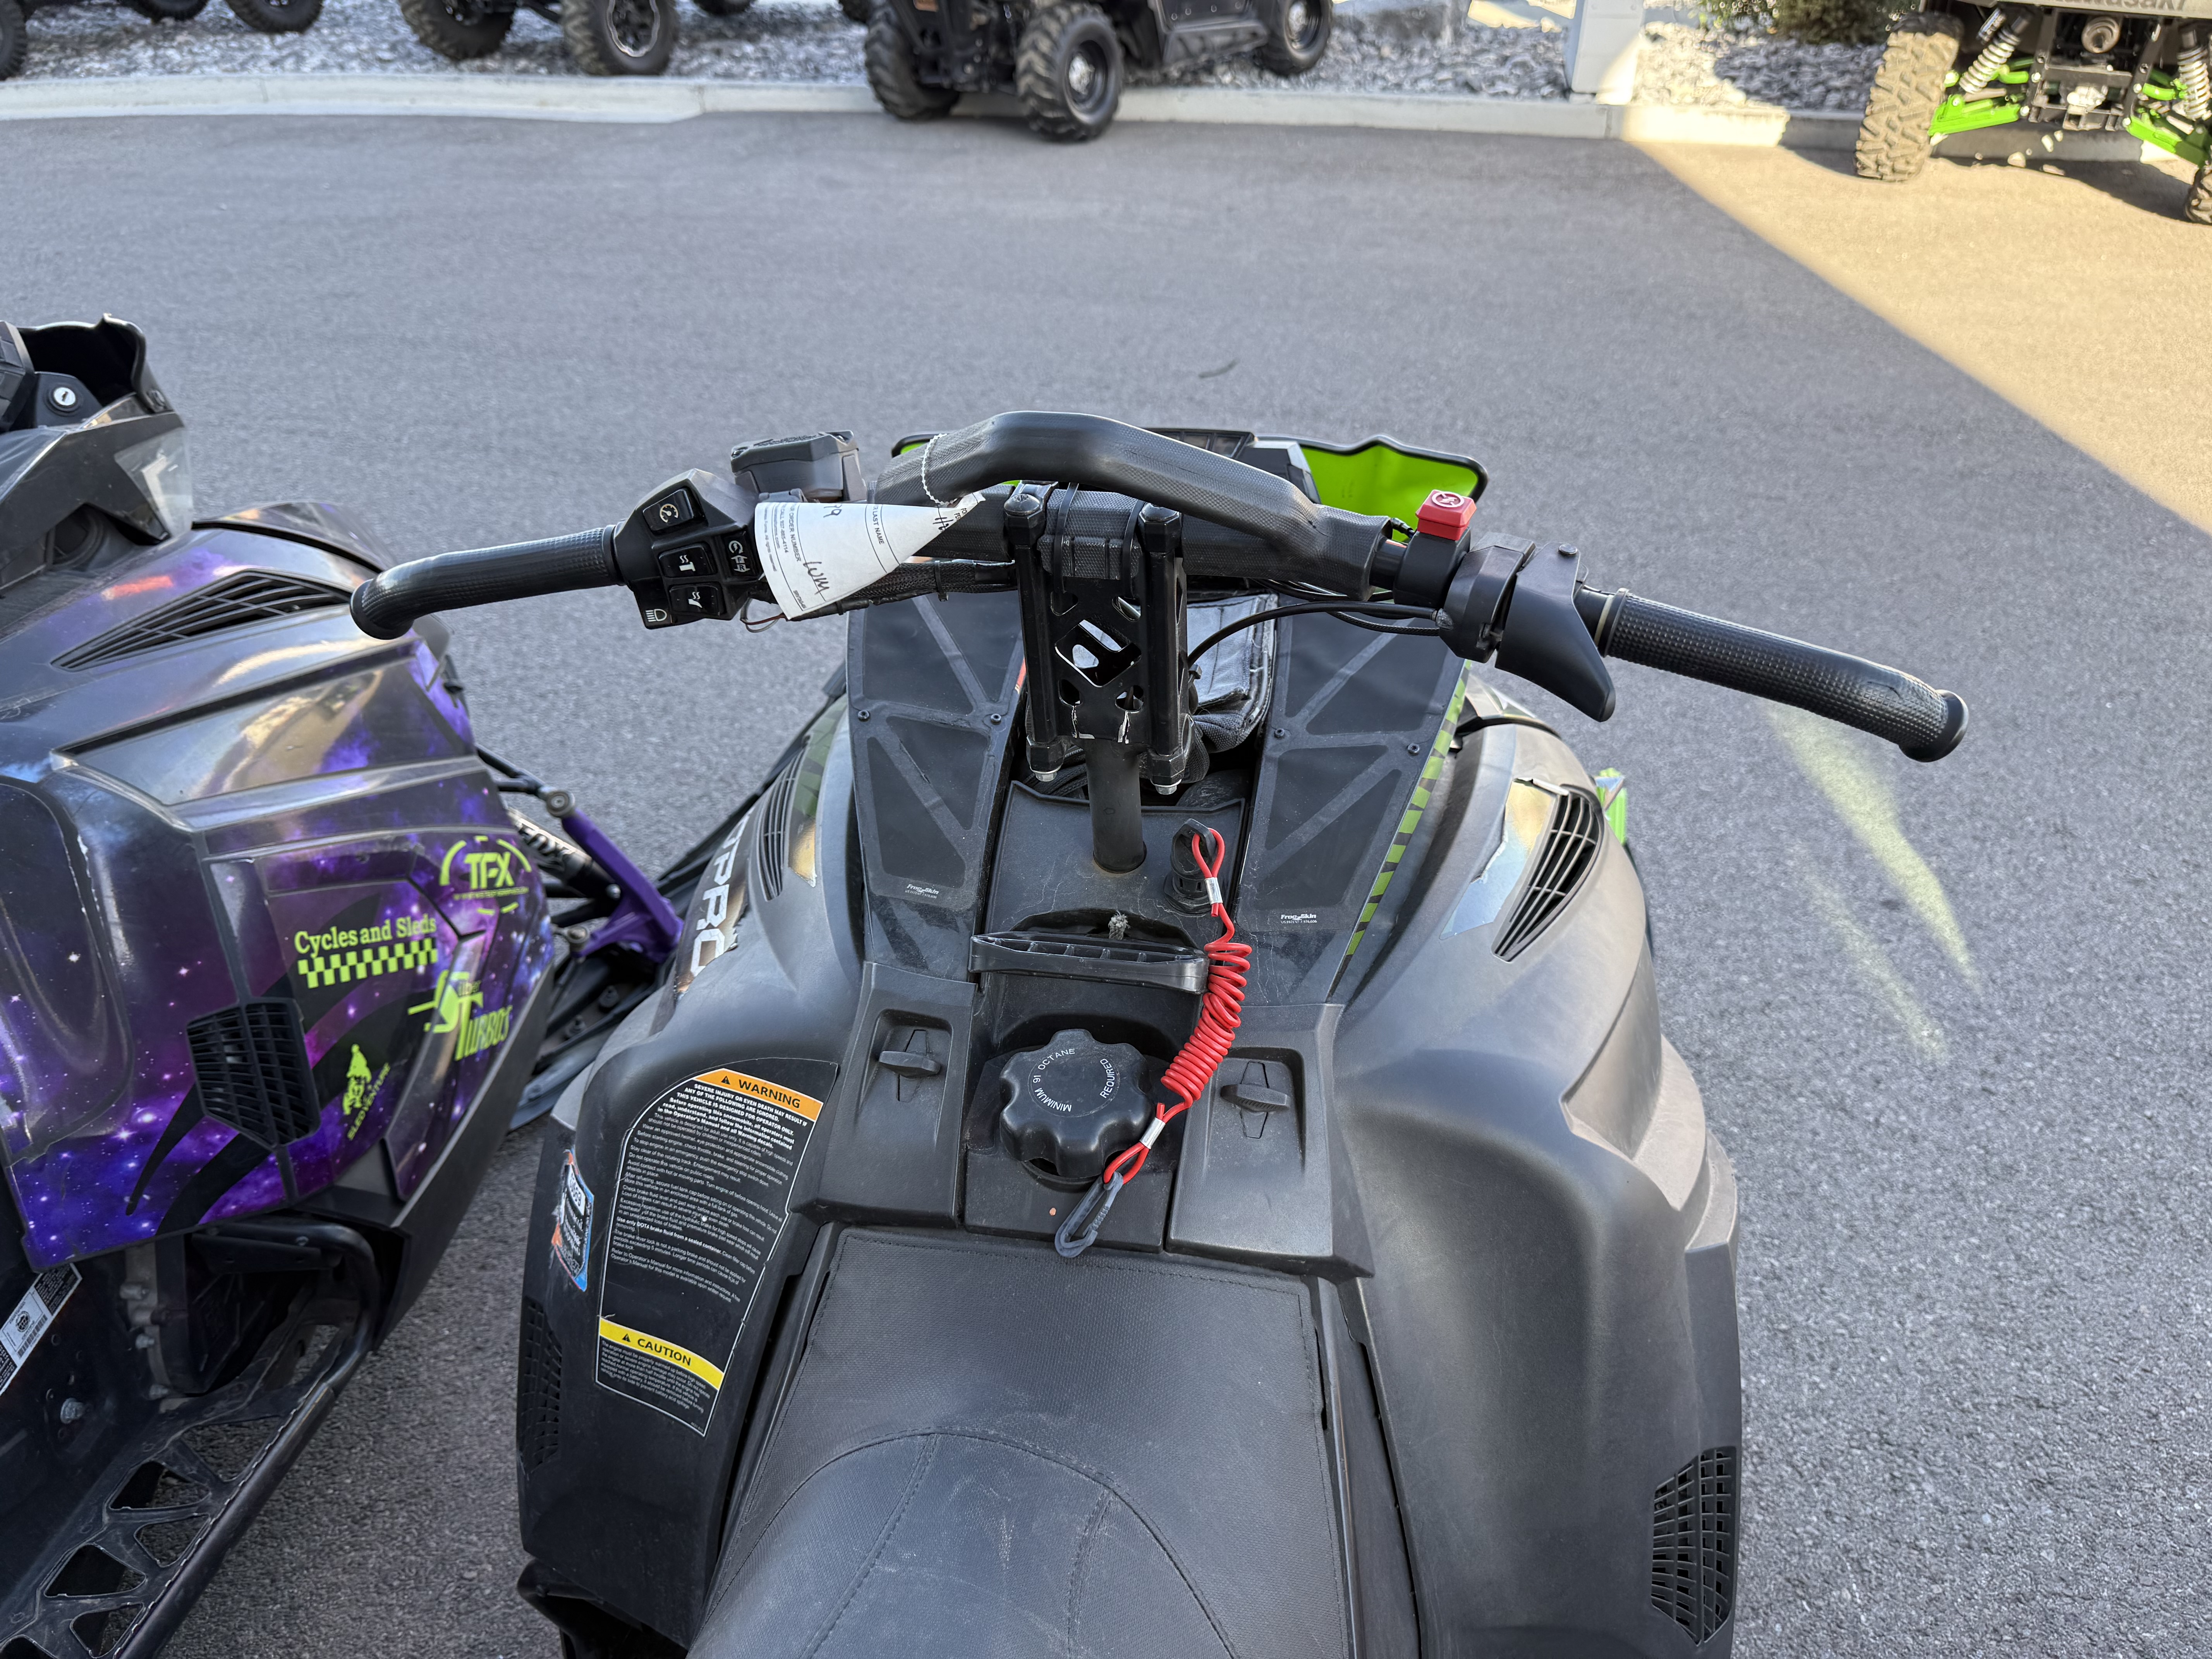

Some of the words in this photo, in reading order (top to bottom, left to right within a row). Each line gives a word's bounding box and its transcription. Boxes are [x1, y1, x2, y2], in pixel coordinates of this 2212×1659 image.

[790, 534, 802, 562] NUMBER
[874, 527, 884, 545] NAME
[464, 851, 515, 890] TFX
[294, 926, 359, 959] Cycles
[360, 918, 393, 945] and
[396, 913, 437, 938] Sleds
[1038, 1048, 1075, 1070] OCTANE
[1033, 1075, 1041, 1083] 91
[1099, 1058, 1115, 1099] REQUIRED
[693, 1084, 715, 1093] SEVERE
[714, 1089, 735, 1099] INJURY
[743, 1098, 757, 1106] EVEN
[757, 1103, 774, 1113] DEATH
[785, 1113, 802, 1125] RESULT
[715, 1096, 745, 1109] FOLLOWING
[738, 1079, 800, 1109] WARNING
[1034, 1087, 1072, 1112] MINIMUM
[669, 1097, 687, 1106] Before
[687, 1102, 713, 1114] operating
[760, 1126, 783, 1139] operators
[689, 1096, 712, 1106] VEHICLE
[718, 1104, 745, 1116] DESIGNED
[755, 1116, 781, 1130] OPERATOR
[701, 1118, 720, 1128] Manual
[737, 1130, 757, 1142] Warning
[718, 1118, 734, 1126] follow
[743, 1126, 770, 1140] information
[770, 1137, 792, 1151] contained
[637, 1338, 692, 1366] CAUTION
